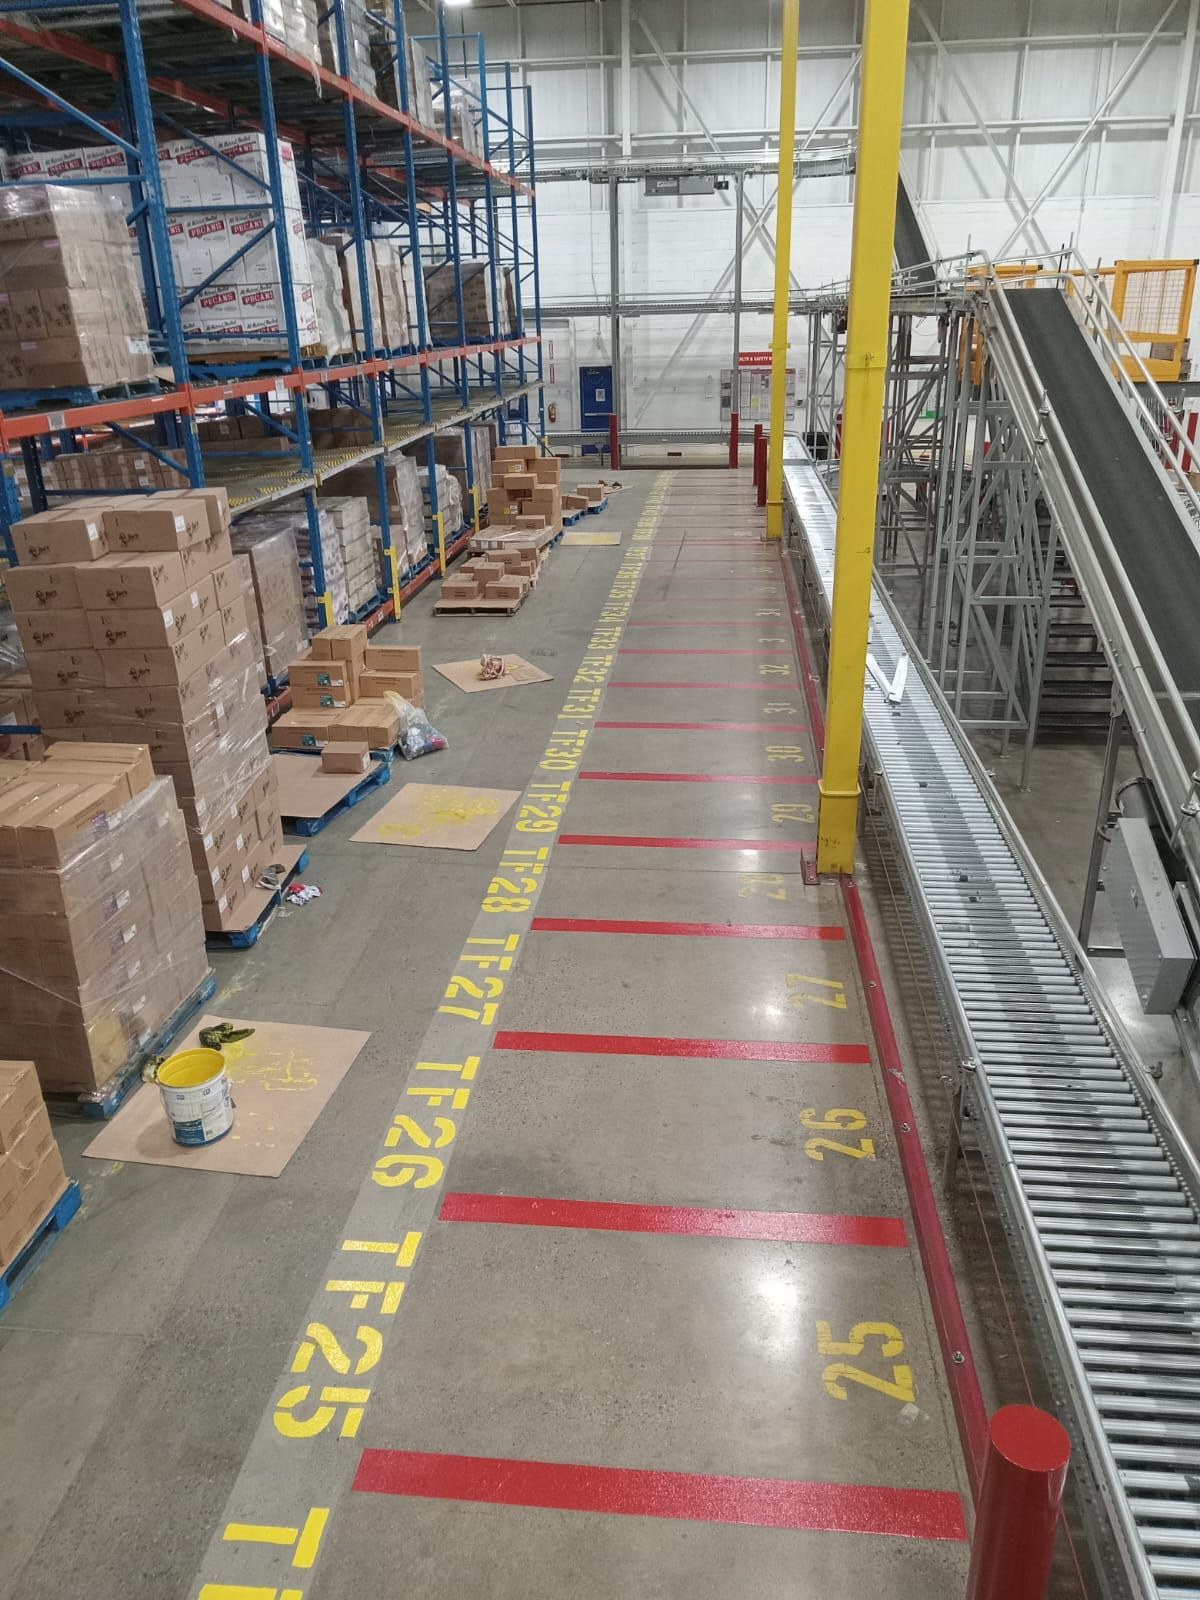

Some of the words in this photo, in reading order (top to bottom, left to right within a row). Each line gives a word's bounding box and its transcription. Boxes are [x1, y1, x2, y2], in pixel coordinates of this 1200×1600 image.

[189, 221, 223, 238] PECANS
[202, 292, 236, 307] PECANS
[599, 602, 630, 622] TF34
[587, 626, 622, 649] TF33
[573, 655, 613, 683] TF32
[759, 664, 790, 675] 32
[557, 688, 602, 719] TF31
[763, 702, 797, 714] 31
[539, 729, 588, 771] TF30
[765, 745, 805, 763] 30
[515, 781, 571, 832] TF29
[770, 803, 816, 823] 29
[481, 847, 549, 912] TF28
[437, 933, 520, 1025] TF27
[786, 974, 847, 1009] 27
[371, 1055, 480, 1189] TF26
[800, 1108, 877, 1162] 26
[273, 1231, 422, 1438] TF25
[815, 1320, 915, 1403] 25
